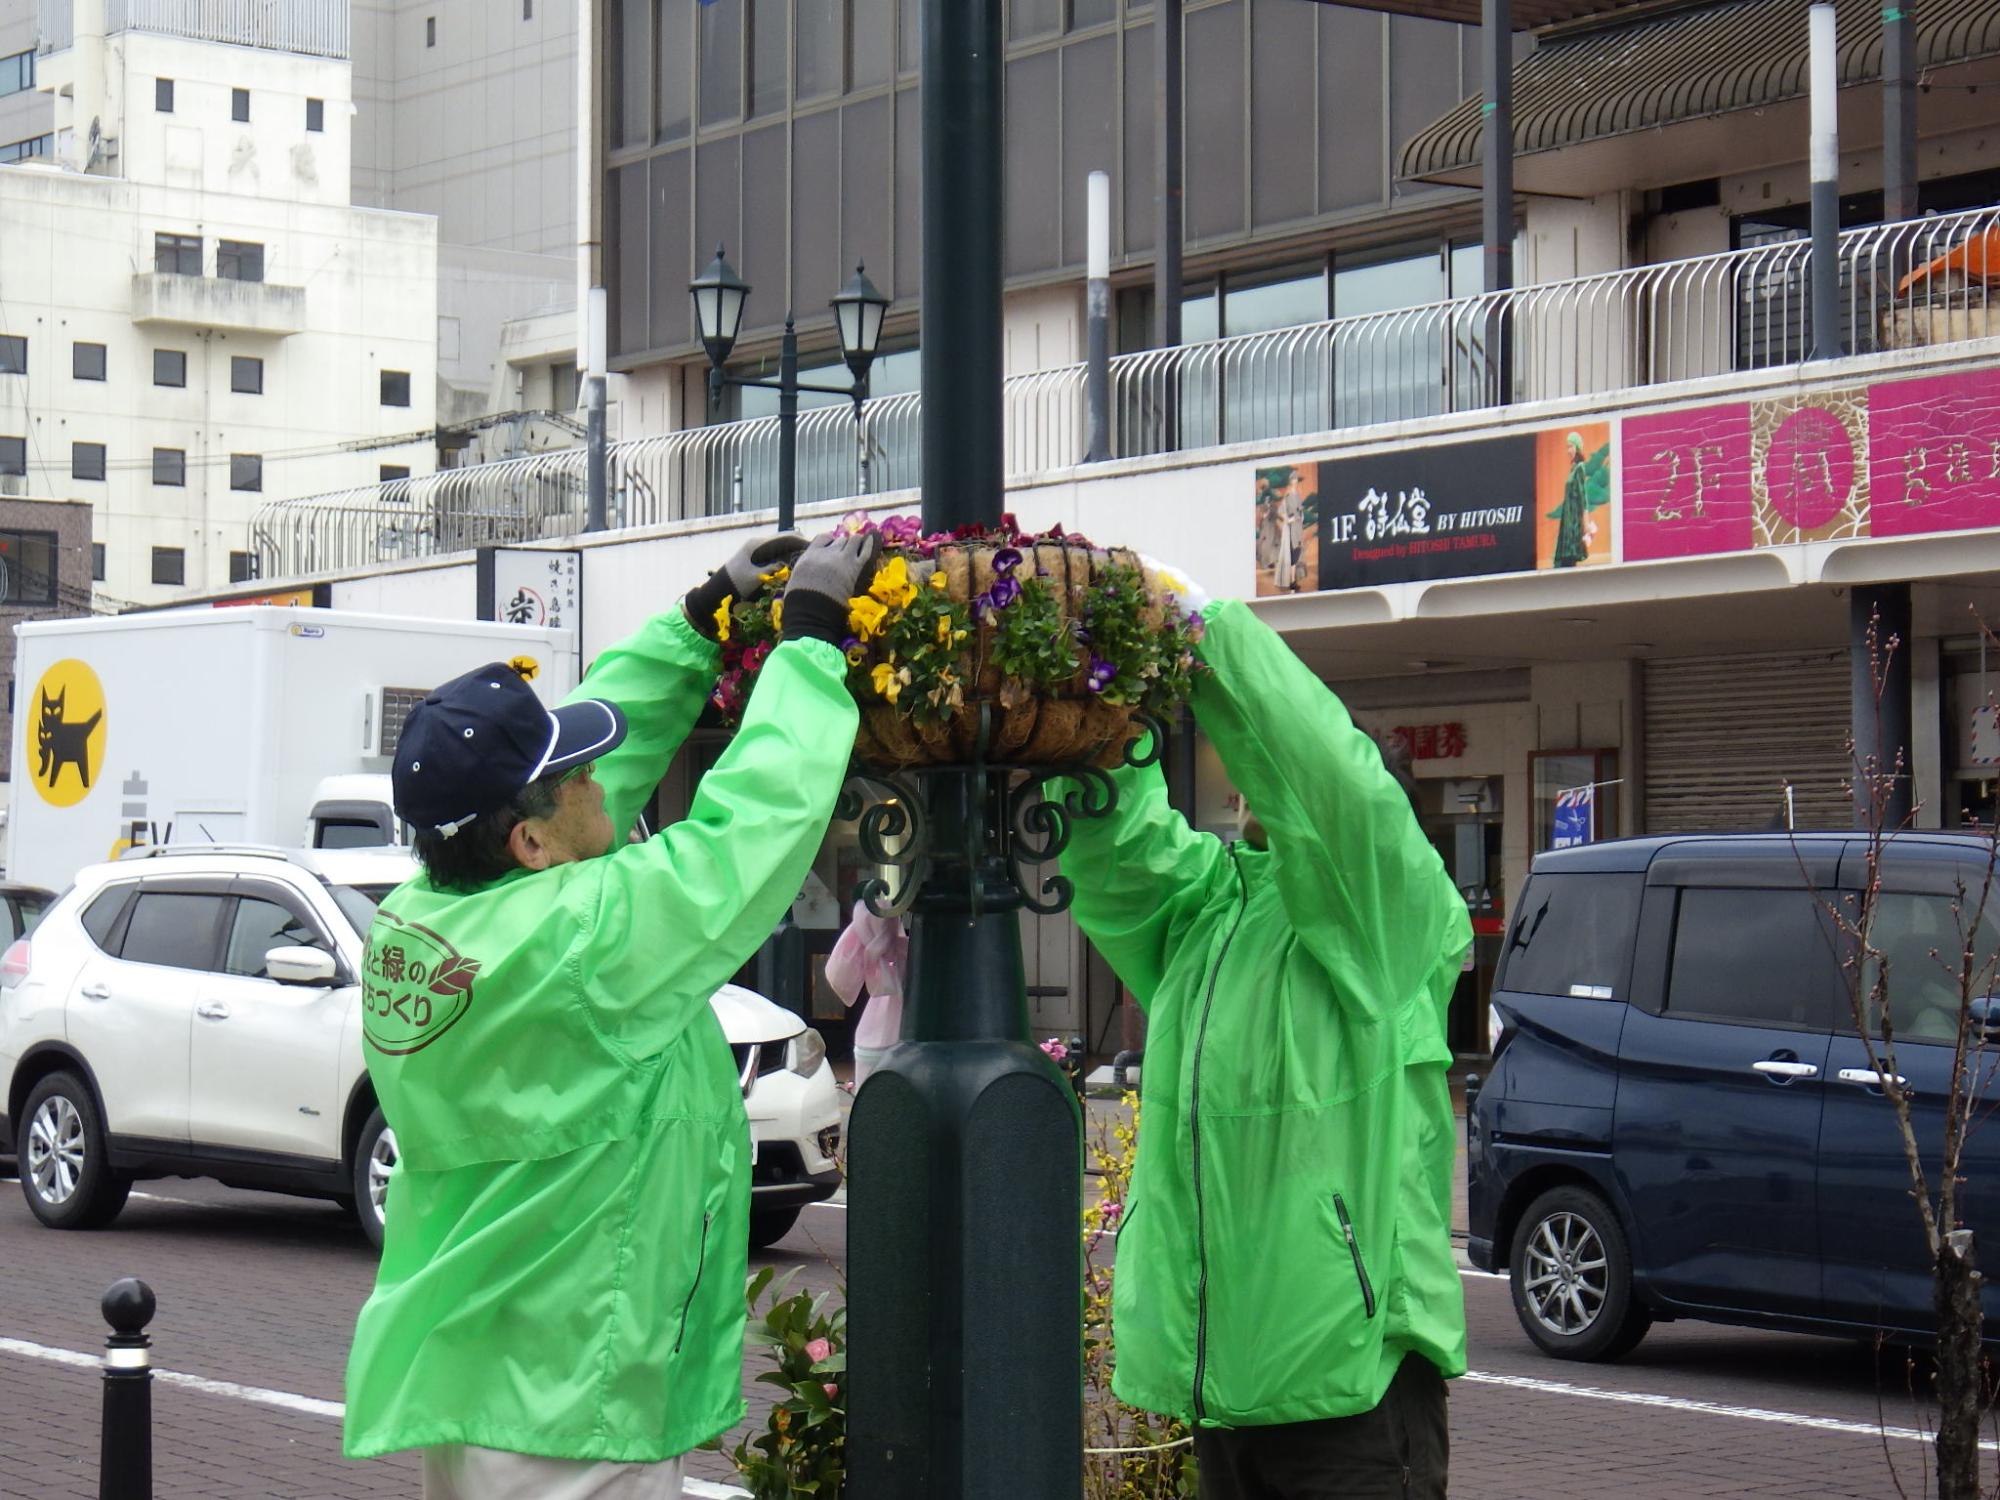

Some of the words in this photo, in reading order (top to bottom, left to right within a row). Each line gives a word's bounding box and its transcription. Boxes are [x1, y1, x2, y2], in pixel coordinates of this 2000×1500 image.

[1437, 513, 1457, 532] BY
[1459, 505, 1524, 529] HITOSHI
[1408, 537, 1451, 556] HITOSHI
[1453, 533, 1497, 550] TAMURA
[362, 983, 433, 1027] ちづくり
